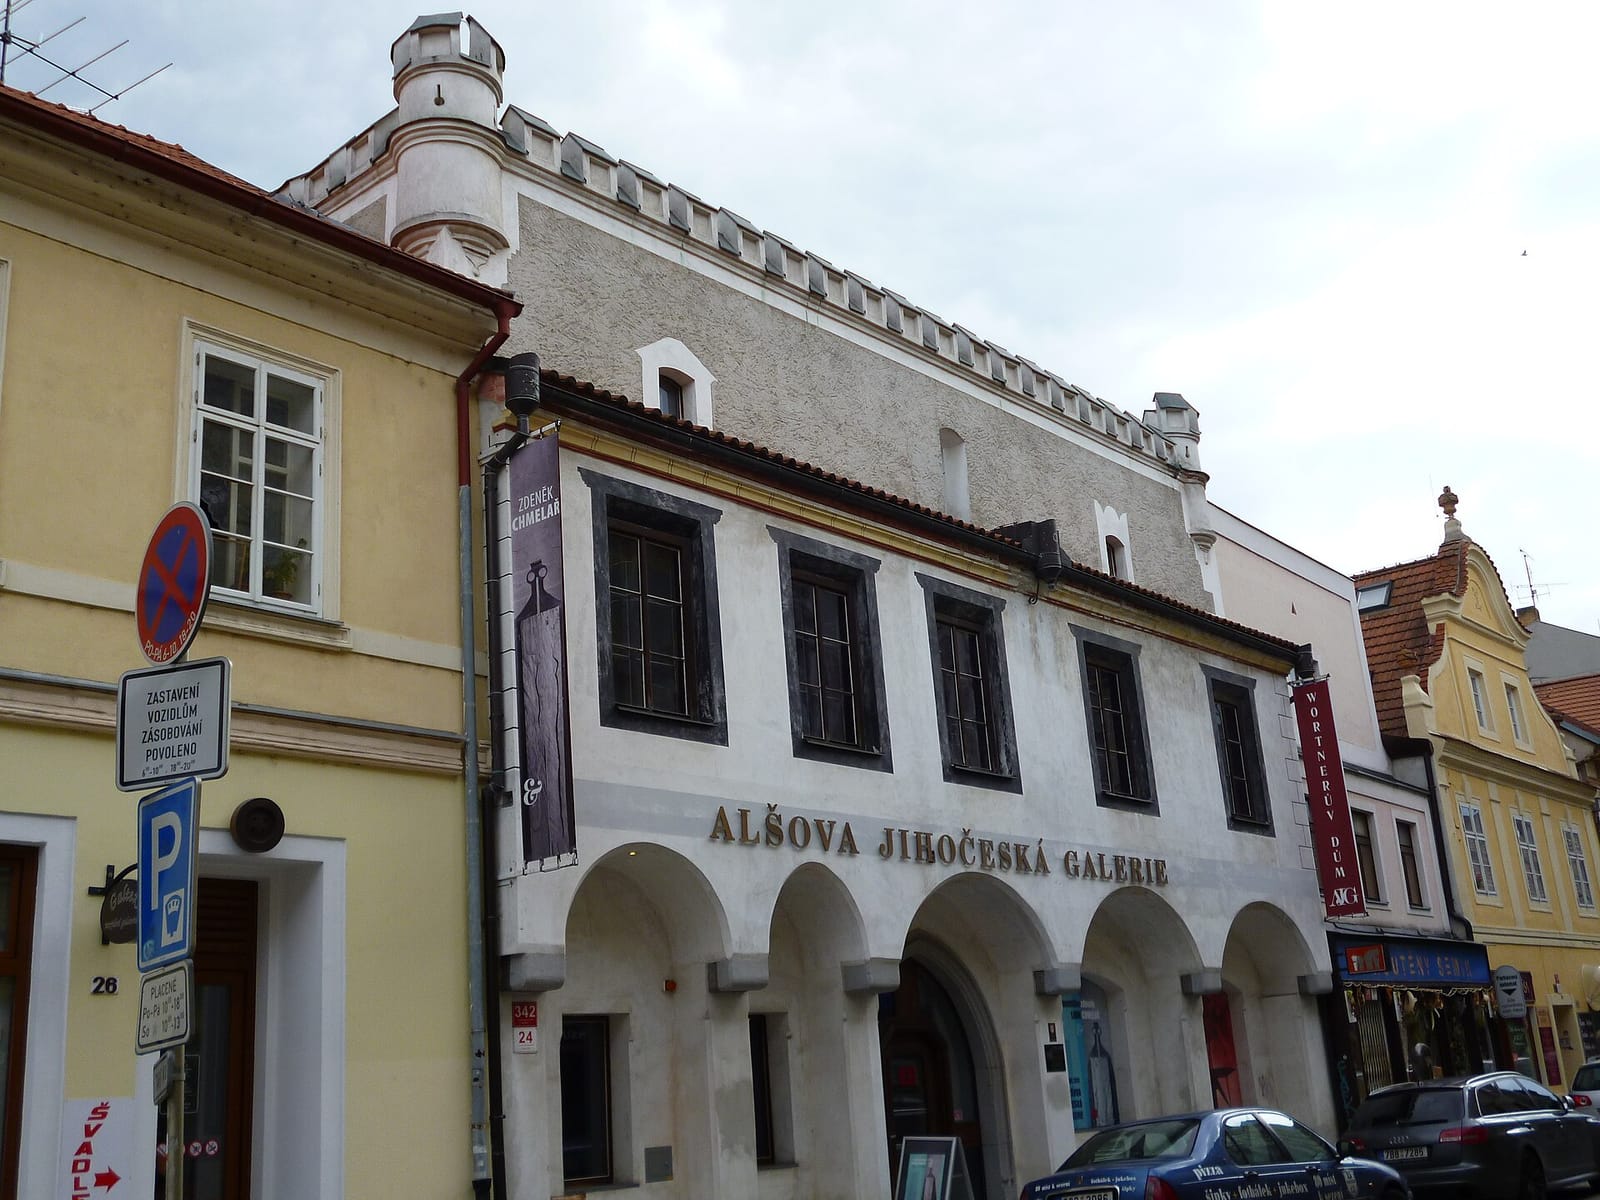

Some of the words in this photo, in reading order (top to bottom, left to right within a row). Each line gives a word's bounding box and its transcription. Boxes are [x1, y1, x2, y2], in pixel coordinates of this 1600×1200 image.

[518, 485, 553, 512] ZDENĚK
[511, 497, 560, 531] CHMELAŘ
[178, 610, 196, 645] 18-20
[146, 681, 200, 705] ZASTAVENÍ
[147, 702, 198, 724] VOZIDLŮM
[141, 719, 203, 744] ZÁSOBOVÁNÍ
[145, 742, 197, 762] POVOLENO
[1306, 691, 1335, 822] WORTNERŮV
[1330, 836, 1347, 879] DŮM
[708, 802, 861, 855] ALŠOVA
[878, 827, 1052, 876] JIHOČESKÁ
[1063, 849, 1170, 885] GALERIE
[150, 810, 183, 911] P
[92, 976, 118, 994] 26
[514, 1005, 536, 1018] 342
[141, 1024, 150, 1039] So
[518, 1031, 533, 1044] 24
[1193, 1164, 1224, 1181] pizza
[1237, 1182, 1273, 1200] fotbálek
[1278, 1179, 1309, 1197] jukebox
